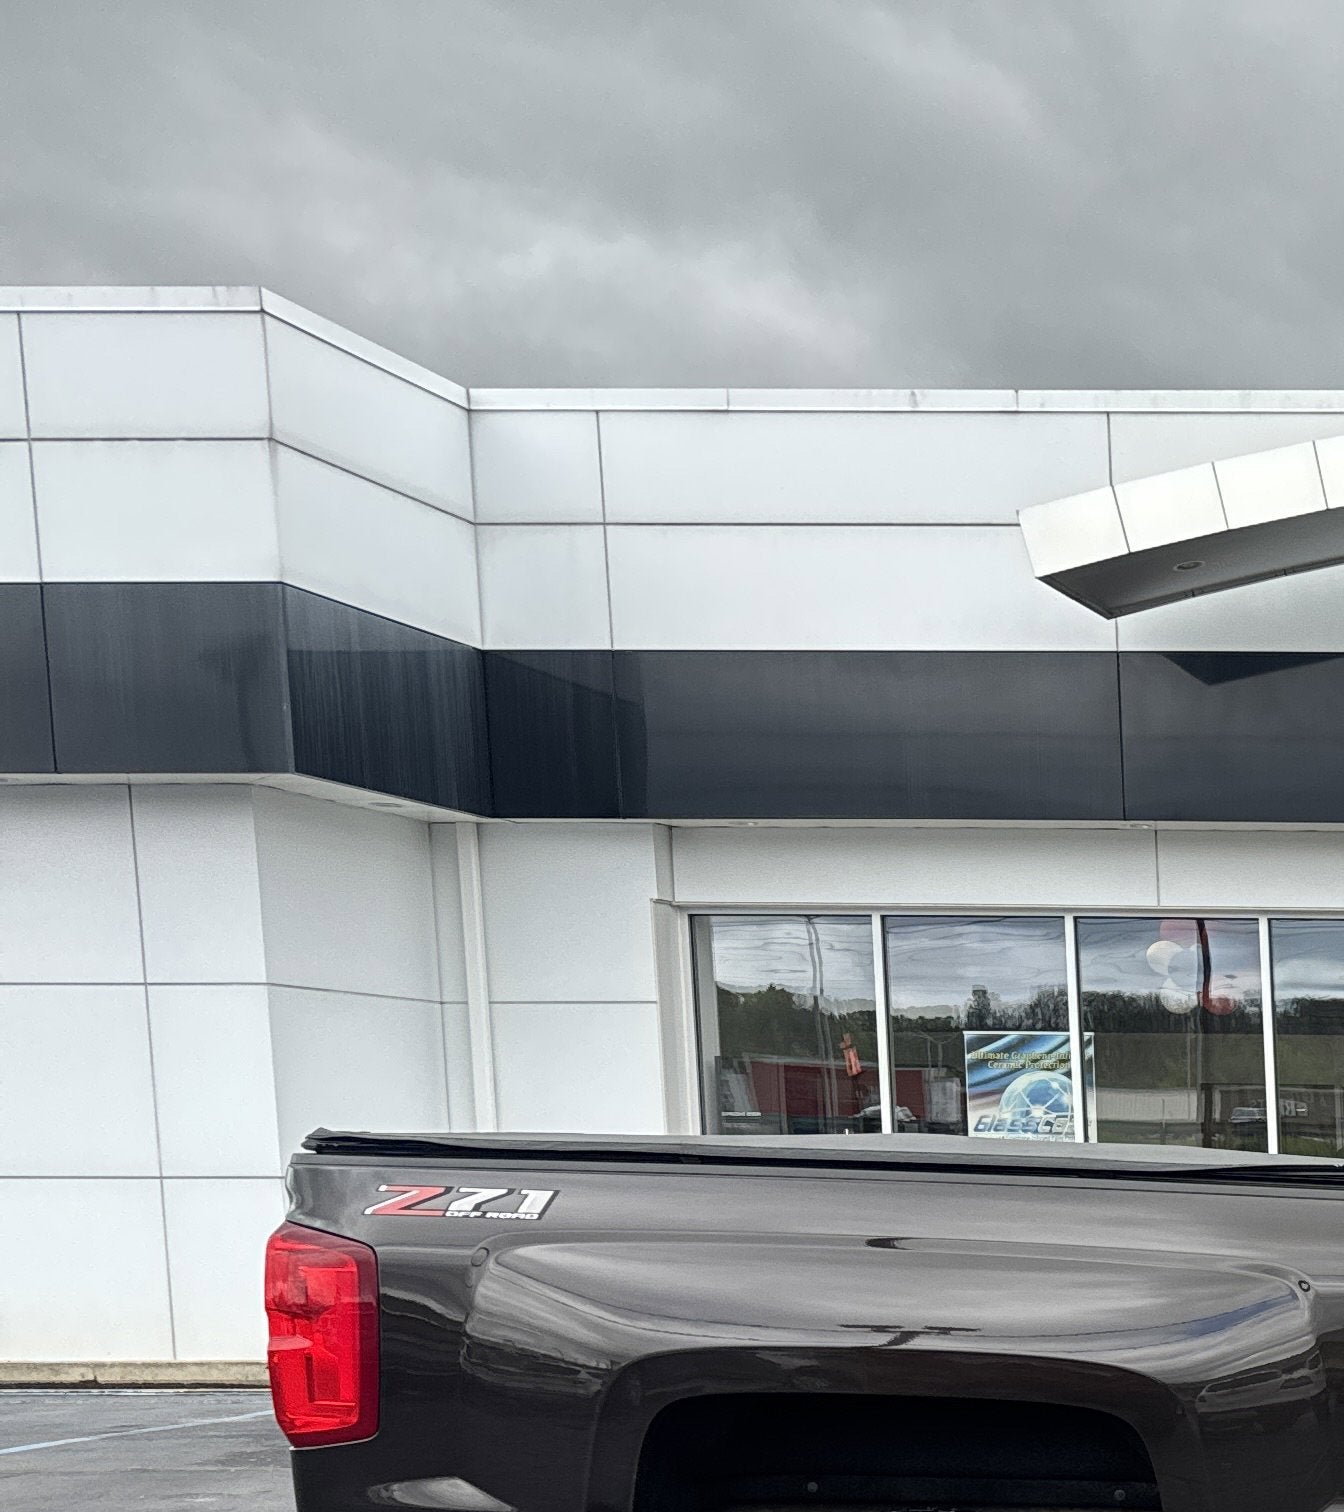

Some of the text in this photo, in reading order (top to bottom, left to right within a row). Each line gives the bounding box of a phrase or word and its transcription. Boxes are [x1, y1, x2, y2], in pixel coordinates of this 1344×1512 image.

[971, 1051, 1009, 1060] Ultimate
[987, 1061, 1024, 1070] Ceramic
[362, 1184, 560, 1217] Z71
[445, 1210, 540, 1220] OFF ROAD
